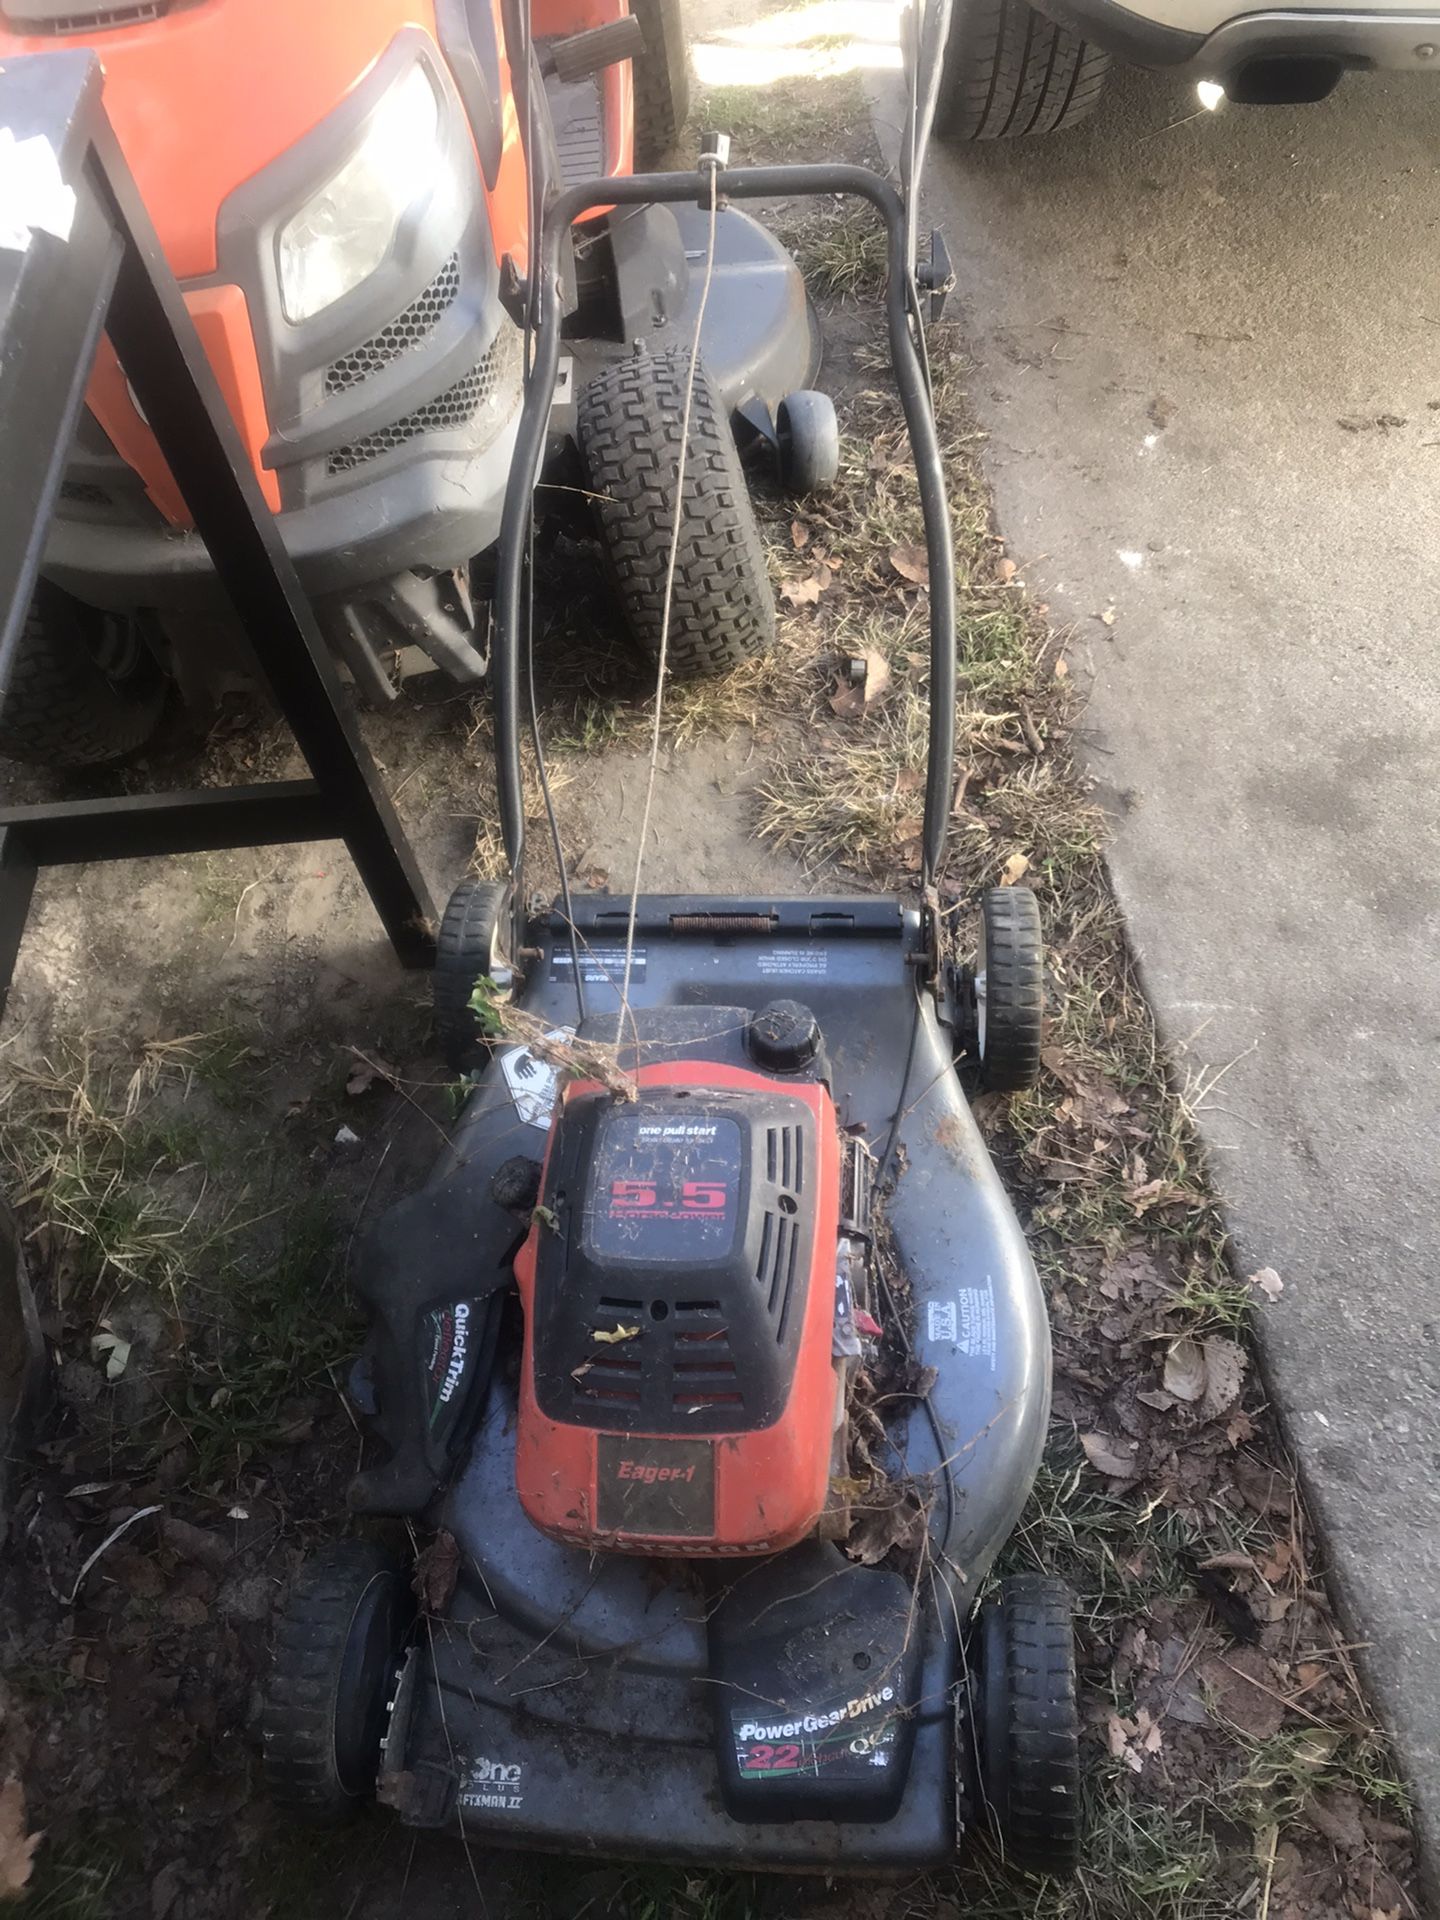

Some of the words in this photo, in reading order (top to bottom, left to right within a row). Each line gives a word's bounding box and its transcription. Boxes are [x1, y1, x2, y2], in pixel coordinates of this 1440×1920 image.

[639, 1126, 662, 1135] one
[662, 1126, 686, 1136] pull
[686, 1126, 717, 1136] start
[610, 1180, 727, 1208] 5.5
[934, 1301, 940, 1312] IN
[958, 1288, 970, 1338] CAUTION
[440, 1303, 470, 1402] QuickTrim
[617, 1462, 696, 1484] Eager-1
[739, 1686, 894, 1742] PowerGearDrive
[746, 1744, 800, 1769] 22
[507, 1797, 524, 1809] II
